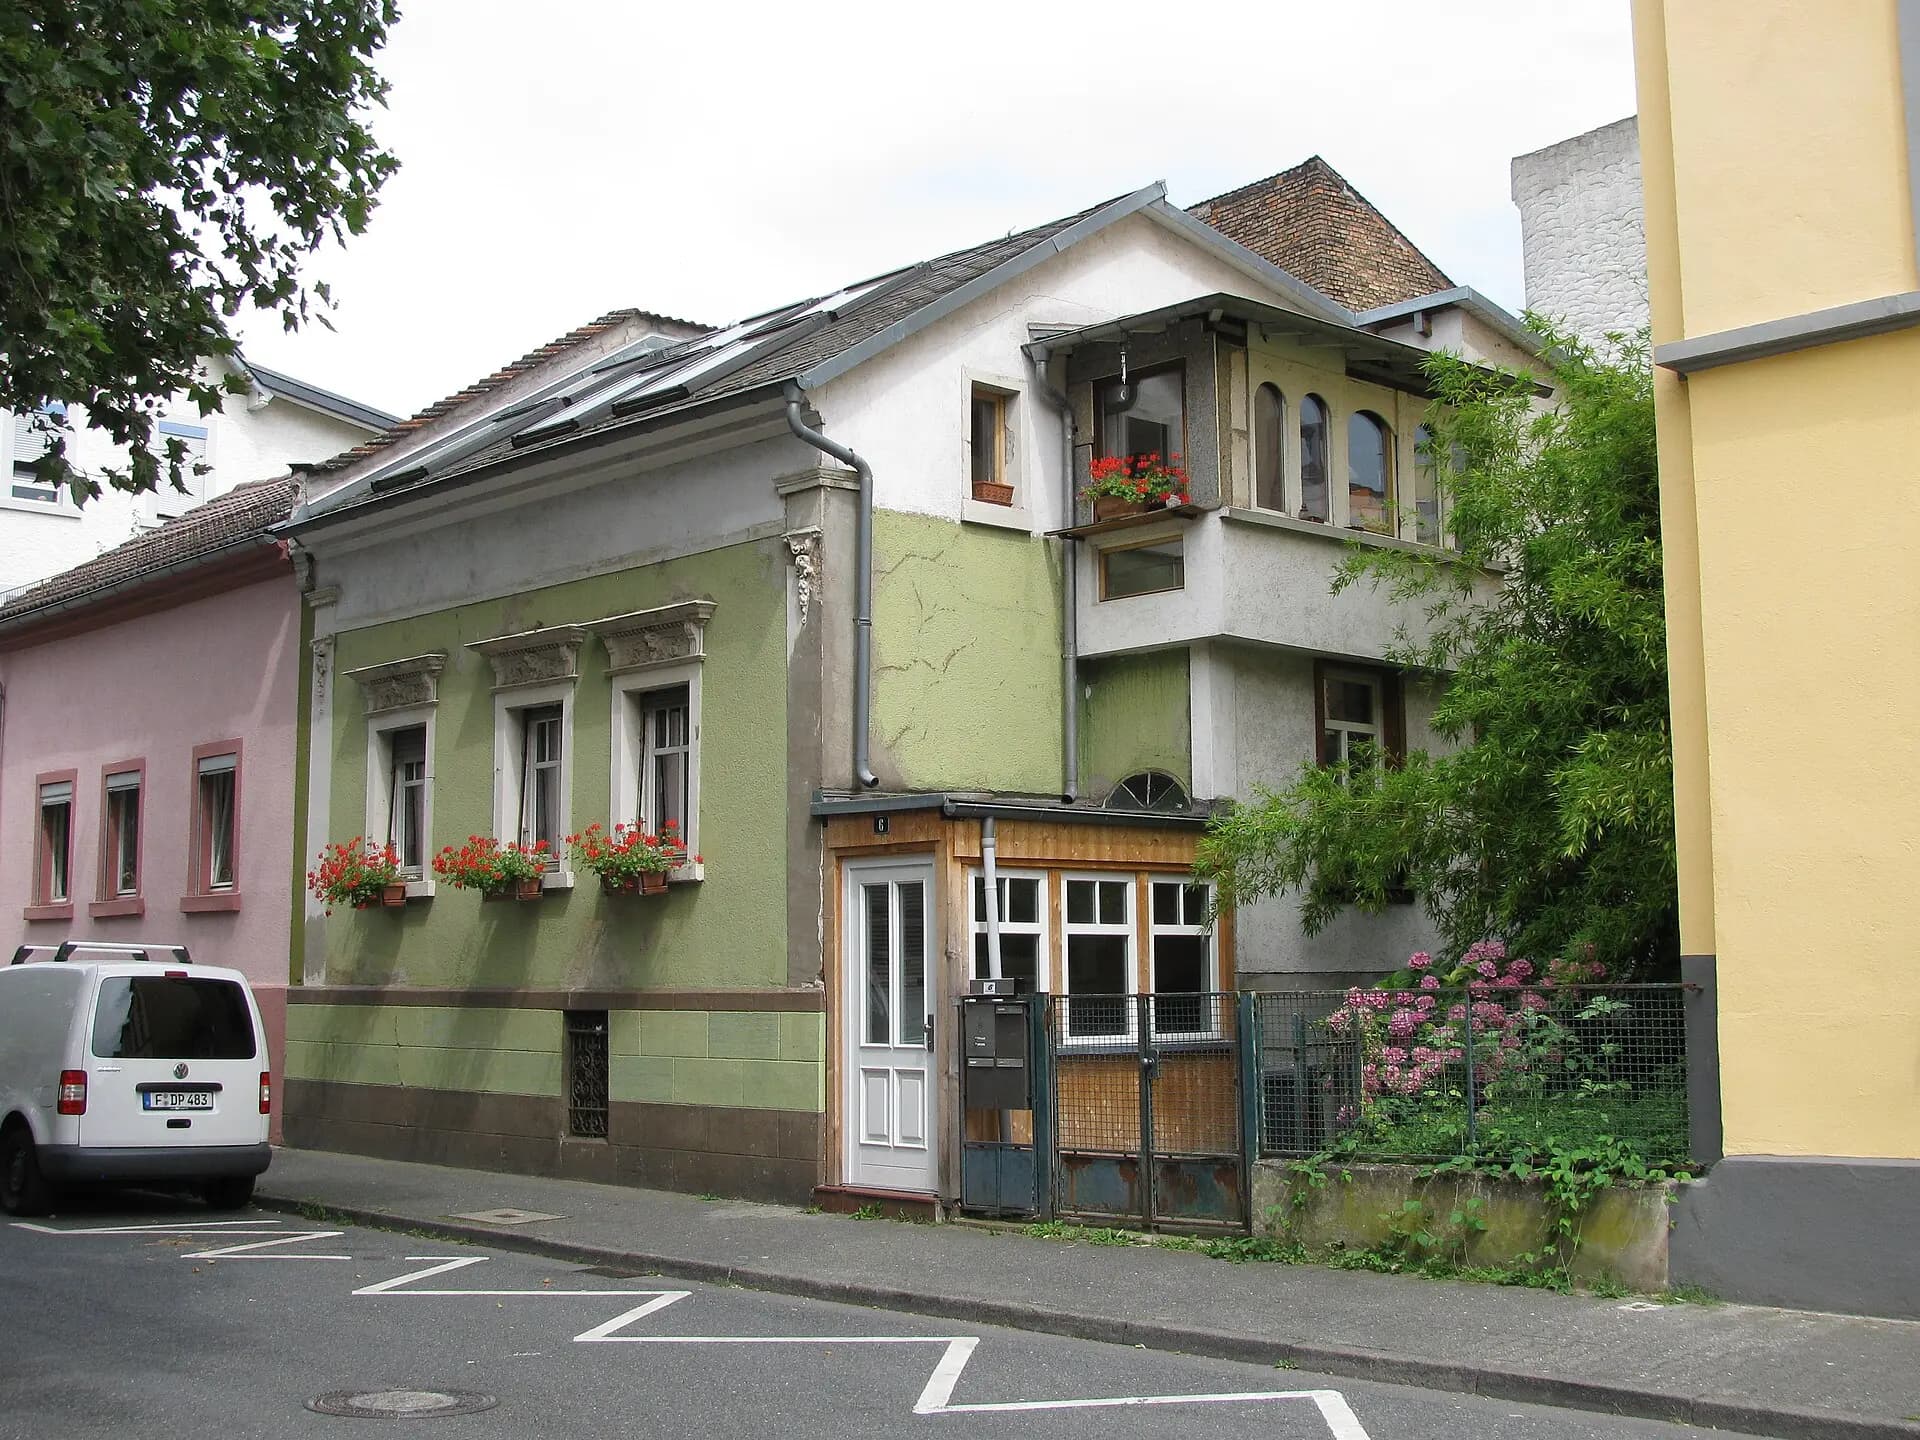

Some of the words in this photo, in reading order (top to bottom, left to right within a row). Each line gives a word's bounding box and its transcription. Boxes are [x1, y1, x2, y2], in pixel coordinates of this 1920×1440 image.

[878, 818, 884, 831] 6
[155, 1094, 162, 1105] F
[170, 1094, 185, 1106] DP
[187, 1094, 208, 1105] 483
